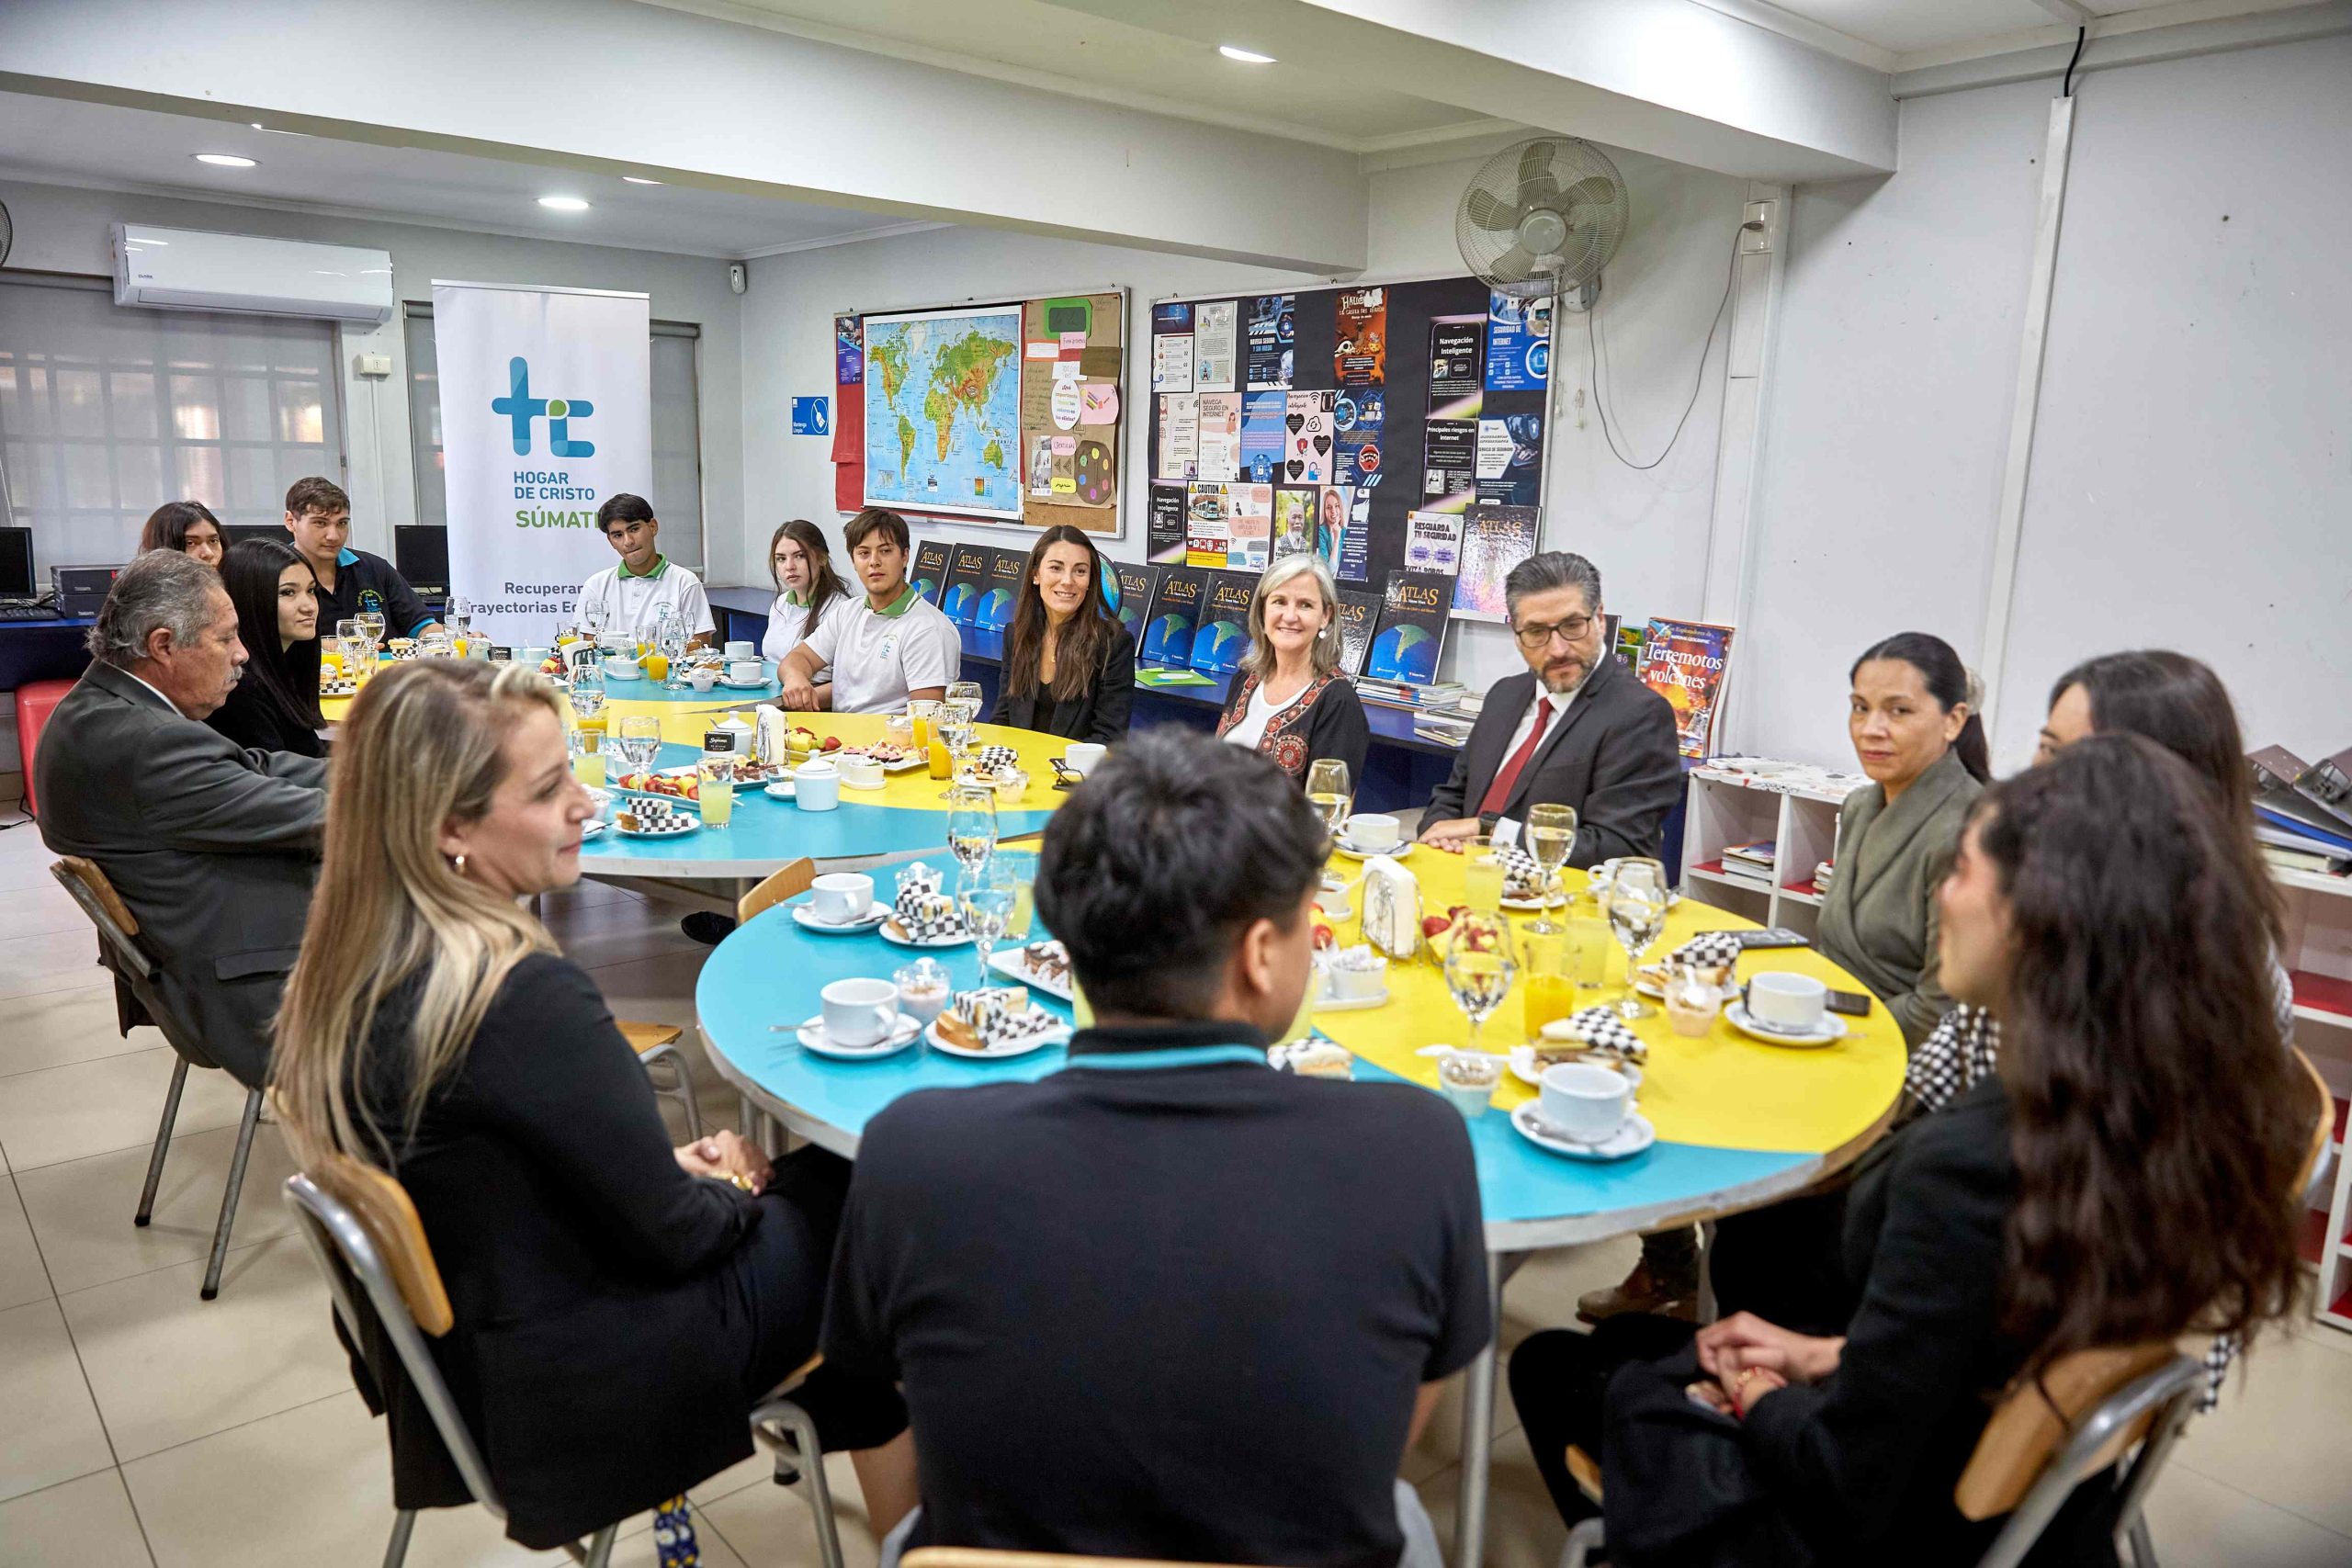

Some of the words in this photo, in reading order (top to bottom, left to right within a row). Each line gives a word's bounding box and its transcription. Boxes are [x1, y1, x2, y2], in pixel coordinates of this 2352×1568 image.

[1493, 325, 1515, 333] SEGURIDAD
[1439, 336, 1474, 345] Navegación
[1492, 337, 1511, 345] INTERNET
[1441, 347, 1473, 355] Inteligente
[514, 471, 569, 484] HOGAR
[514, 487, 535, 499] DE
[539, 488, 594, 500] CRISTO
[1197, 484, 1219, 494] CAUTION
[1414, 522, 1450, 532] RESGUARDA
[1423, 531, 1456, 542] SEGURIDAD
[921, 551, 944, 566] ATLAS
[957, 554, 982, 570] ATLAS
[994, 558, 1020, 575] ATLAS
[1164, 581, 1196, 598] ATLAS
[1215, 587, 1250, 605] ATLAS
[1396, 586, 1439, 606] ATLAS
[1338, 604, 1365, 623] TLAS
[1646, 641, 1723, 670] Terremotos
